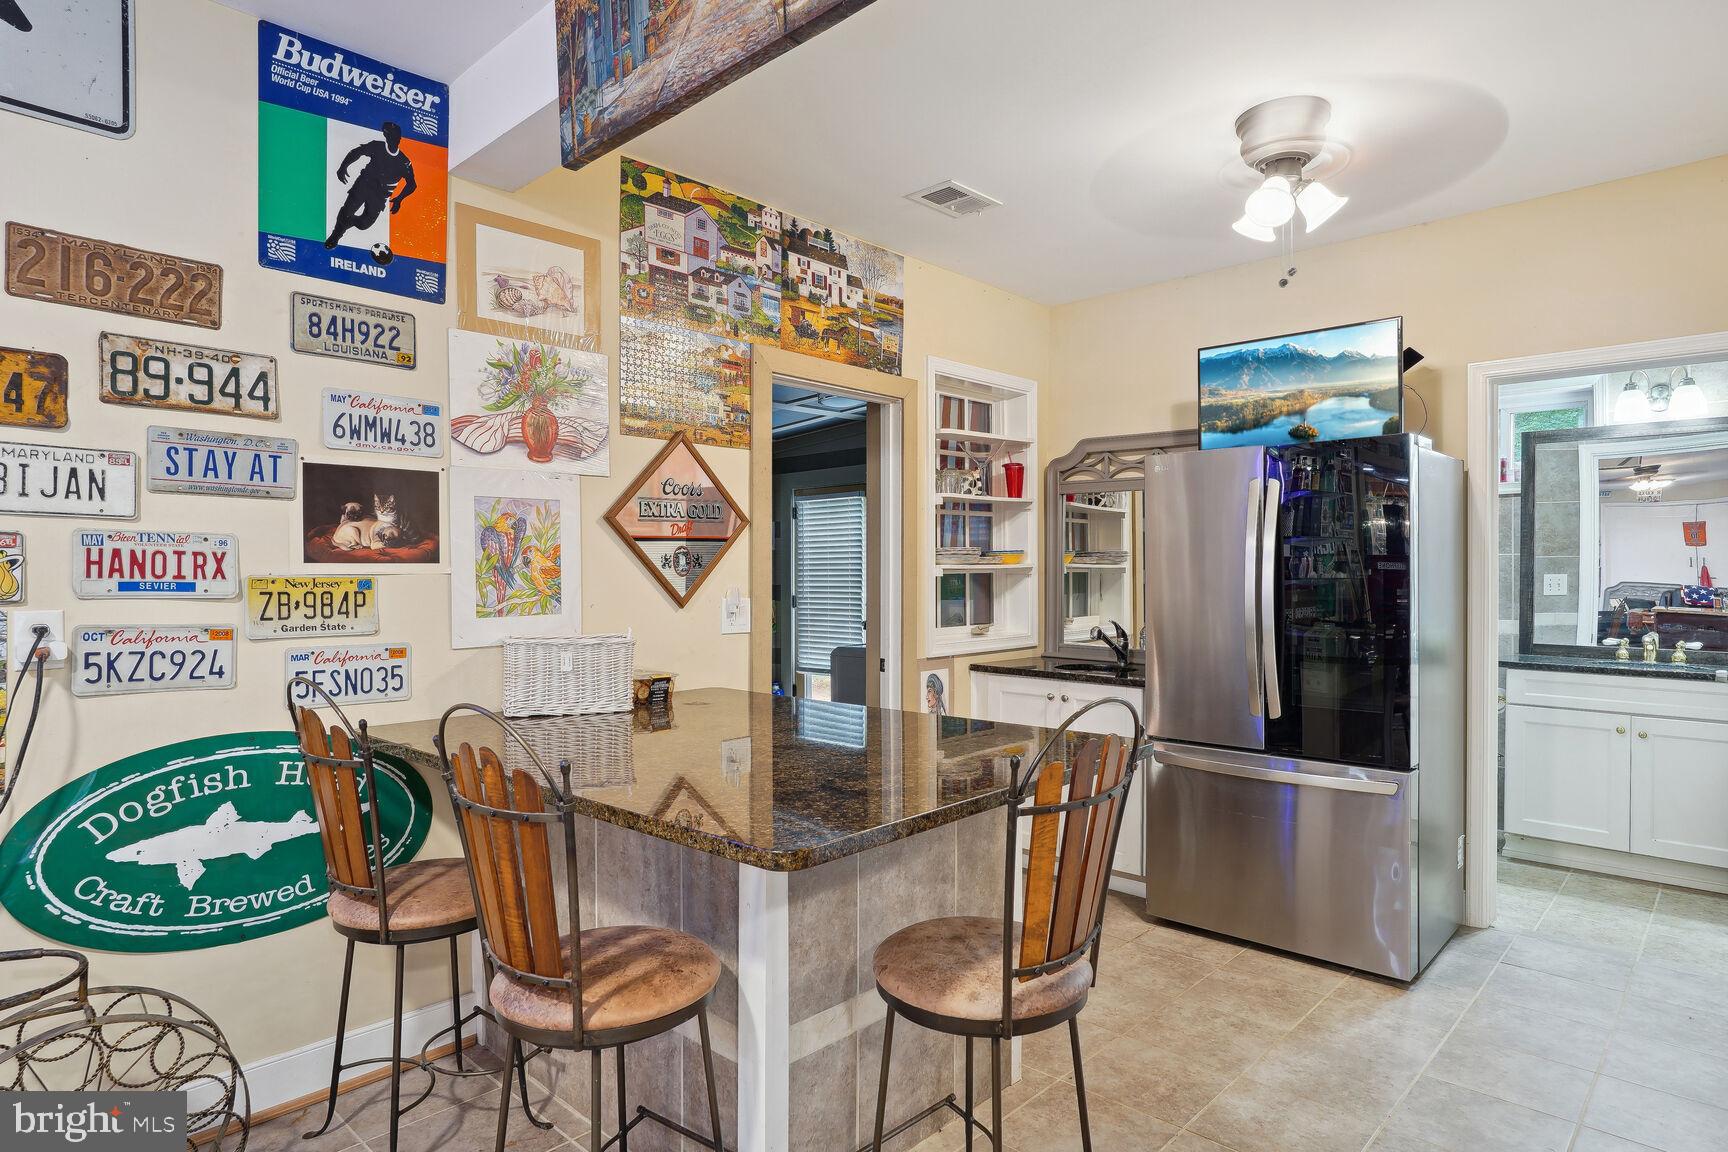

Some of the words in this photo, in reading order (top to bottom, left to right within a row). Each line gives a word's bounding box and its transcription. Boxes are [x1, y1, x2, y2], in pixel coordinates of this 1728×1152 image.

[271, 64, 299, 80] Official
[300, 74, 319, 86] Beer
[272, 32, 441, 112] Budweiser
[271, 73, 295, 88] World
[296, 82, 311, 94] Cup
[313, 87, 329, 99] USA
[61, 237, 178, 267] MARYLAND
[17, 238, 213, 317] 216-222
[196, 264, 218, 276] 1934
[330, 257, 386, 278] IRELAND
[56, 291, 180, 320] TERCENTENARY
[300, 297, 362, 315] SPORTSMAN'S
[365, 308, 406, 323] PARADISE
[308, 311, 401, 351] 84H922
[323, 341, 389, 361] LOUISIANA
[400, 355, 412, 363] 92
[330, 393, 347, 404] MAY
[350, 395, 421, 415] California
[332, 412, 436, 448] 6WMW438
[1, 447, 95, 464] MARYLAND
[355, 442, 415, 452] dmv.ca.gov
[165, 446, 237, 480] STAY
[249, 453, 282, 483] AT
[661, 477, 704, 497] Coors
[639, 501, 686, 518] EXTRA
[687, 503, 723, 520] GOLD
[670, 520, 694, 537] Draft
[83, 534, 103, 546] MAY
[85, 547, 227, 580] HANOIRX
[139, 582, 176, 590] SEVIER
[284, 578, 310, 588] New
[311, 578, 342, 590] Jersey
[281, 624, 317, 633] Garden
[320, 623, 347, 631] State
[82, 632, 105, 642] OCT
[110, 629, 208, 649] California
[83, 649, 225, 684] 5KZC924
[290, 654, 310, 662] MAR
[313, 650, 388, 667] California
[77, 765, 251, 845] Dogfish
[74, 875, 165, 917] Craft
[184, 874, 316, 917] Brewed
